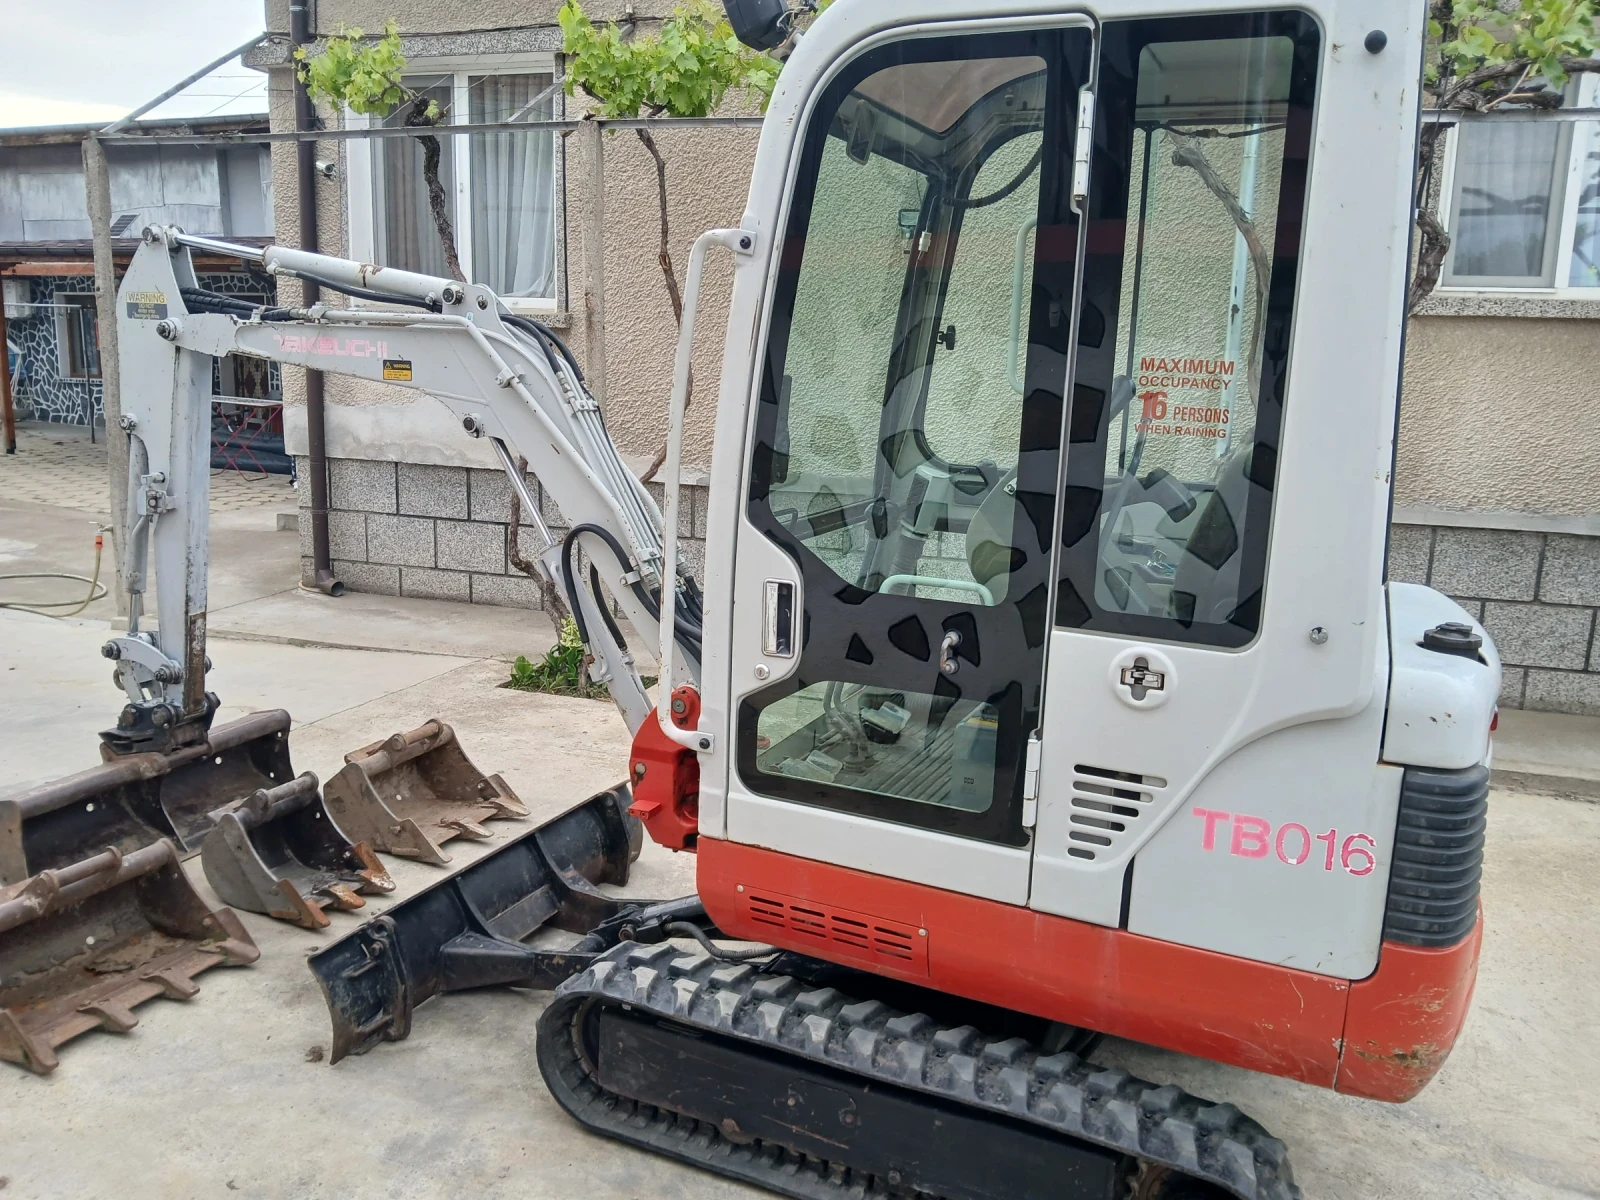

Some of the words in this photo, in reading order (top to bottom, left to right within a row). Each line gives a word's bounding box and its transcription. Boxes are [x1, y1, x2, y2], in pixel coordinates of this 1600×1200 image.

[128, 293, 165, 303] WARNING
[1140, 357, 1234, 375] MAXIMUM
[1138, 375, 1231, 390] OCCUPANCY
[1138, 390, 1168, 420] 16
[1173, 406, 1230, 424] PERSONS
[1134, 424, 1171, 435] WHEN
[1174, 425, 1227, 438] RAINING
[1192, 806, 1377, 876] TB016
